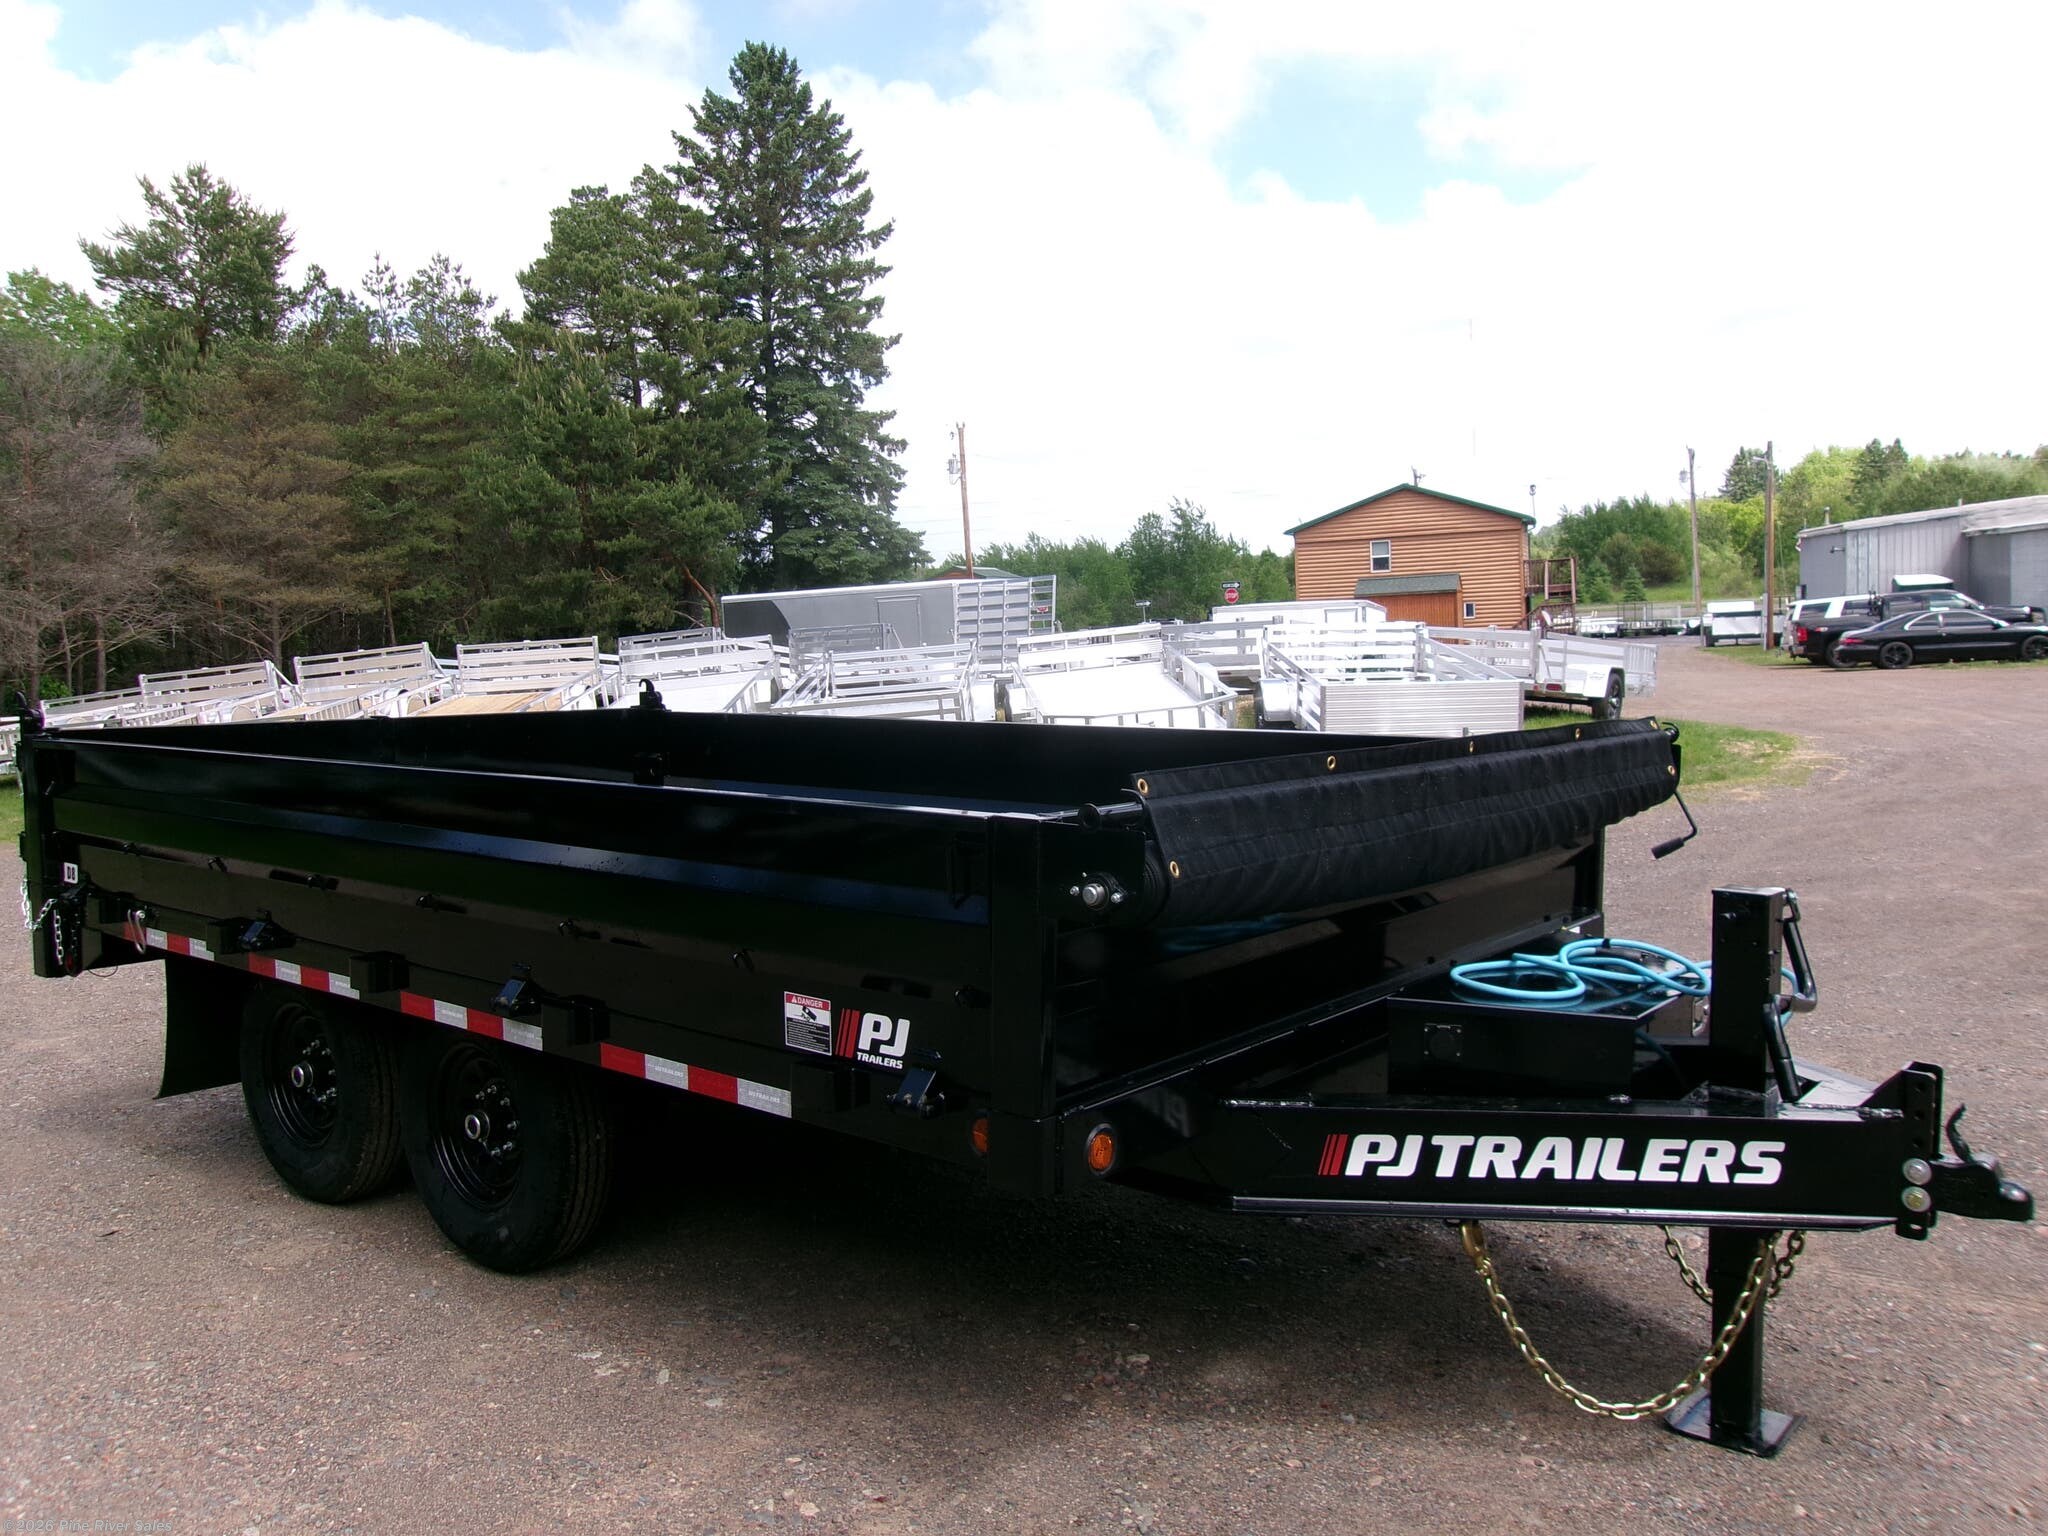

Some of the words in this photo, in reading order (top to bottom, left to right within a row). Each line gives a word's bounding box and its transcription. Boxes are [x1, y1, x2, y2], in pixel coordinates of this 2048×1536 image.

[797, 997, 823, 1009] DANGER
[858, 1012, 910, 1057] PJ
[857, 1051, 903, 1069] TRAILERS
[1344, 1134, 1423, 1176] PJ
[1431, 1135, 1786, 1184] TRAILERS
